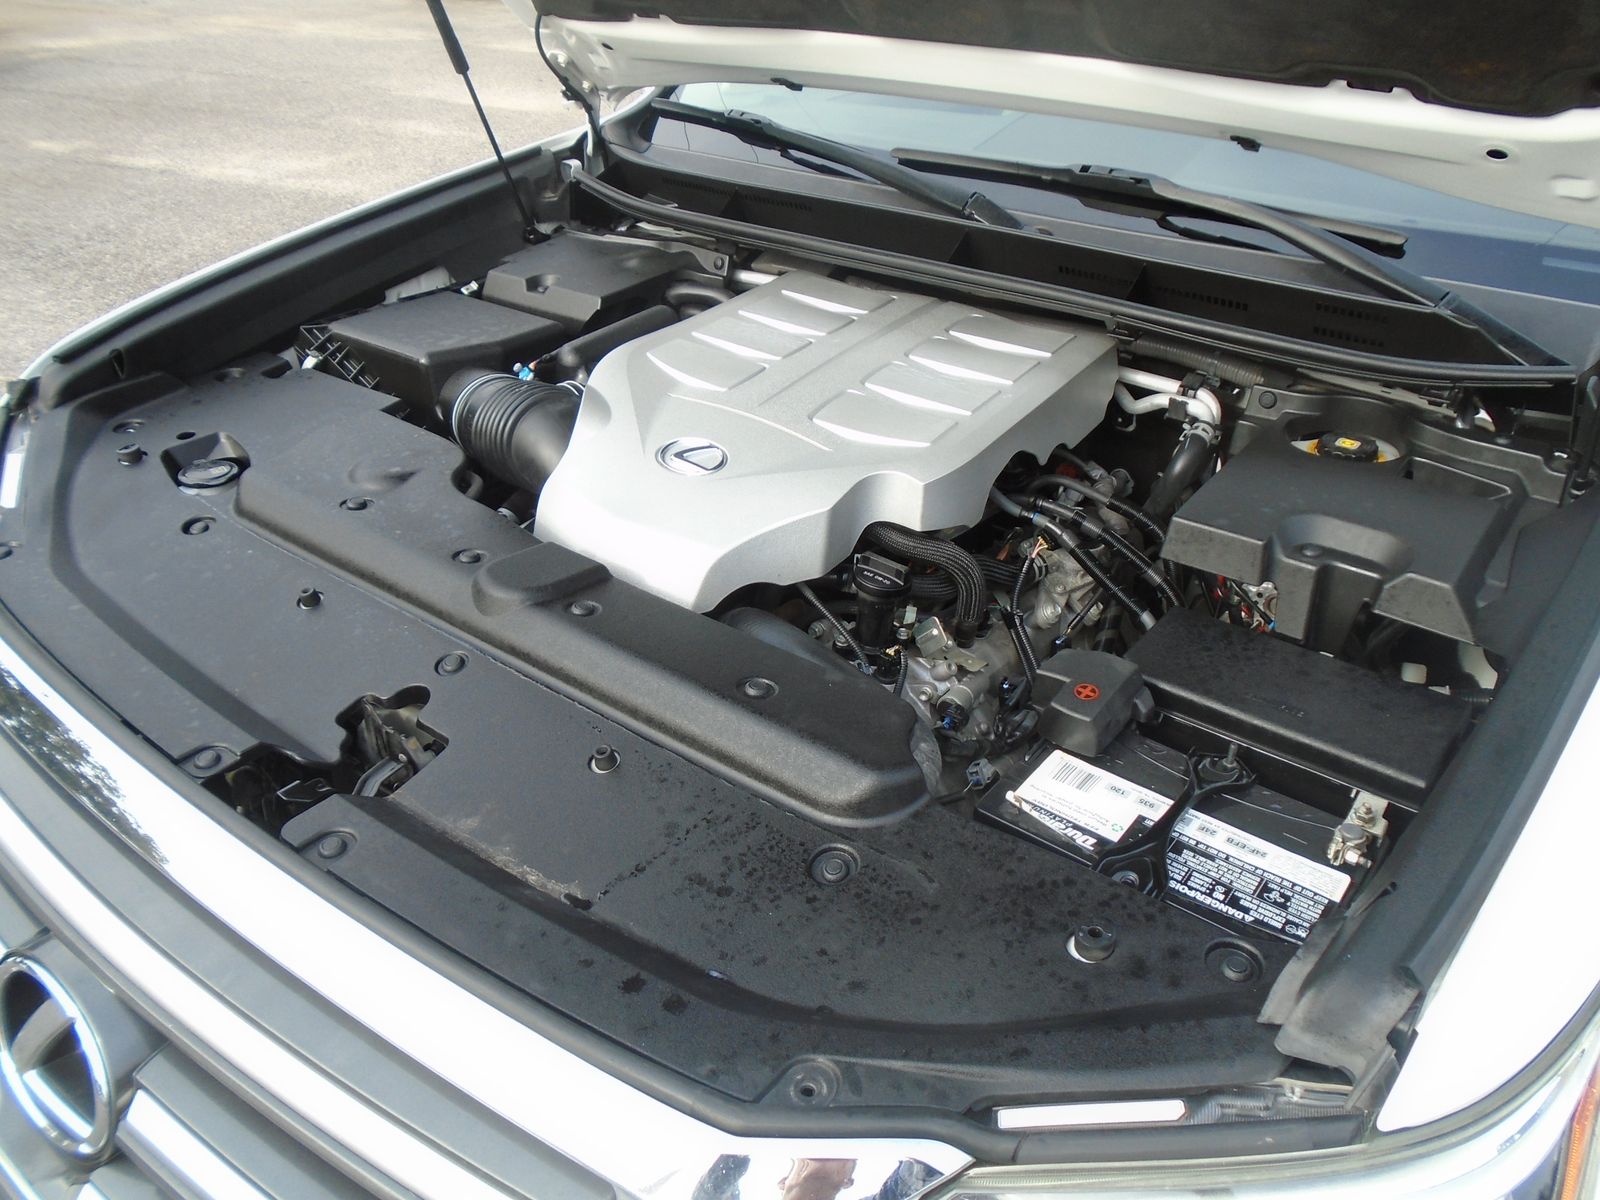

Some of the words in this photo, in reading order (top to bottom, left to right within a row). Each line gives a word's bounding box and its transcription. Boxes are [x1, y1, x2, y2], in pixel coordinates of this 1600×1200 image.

[1109, 784, 1125, 795] 120
[1137, 797, 1155, 809] 935
[1197, 824, 1216, 836] 24F
[1178, 833, 1189, 842] NOT
[1206, 846, 1218, 855] NOT
[1225, 836, 1267, 858] 24F-EFB
[1255, 867, 1263, 875] OF
[1262, 871, 1281, 883] REACH
[1281, 879, 1292, 887] THE
[1292, 884, 1302, 892] OF
[1301, 888, 1314, 897] OUT
[1313, 893, 1328, 903] KEEP
[1167, 878, 1246, 920] DANGER/POIS
[1248, 909, 1264, 920] EYES
[1256, 906, 1286, 923] EXPLOSIVE
[1262, 916, 1282, 929] SHIELD
